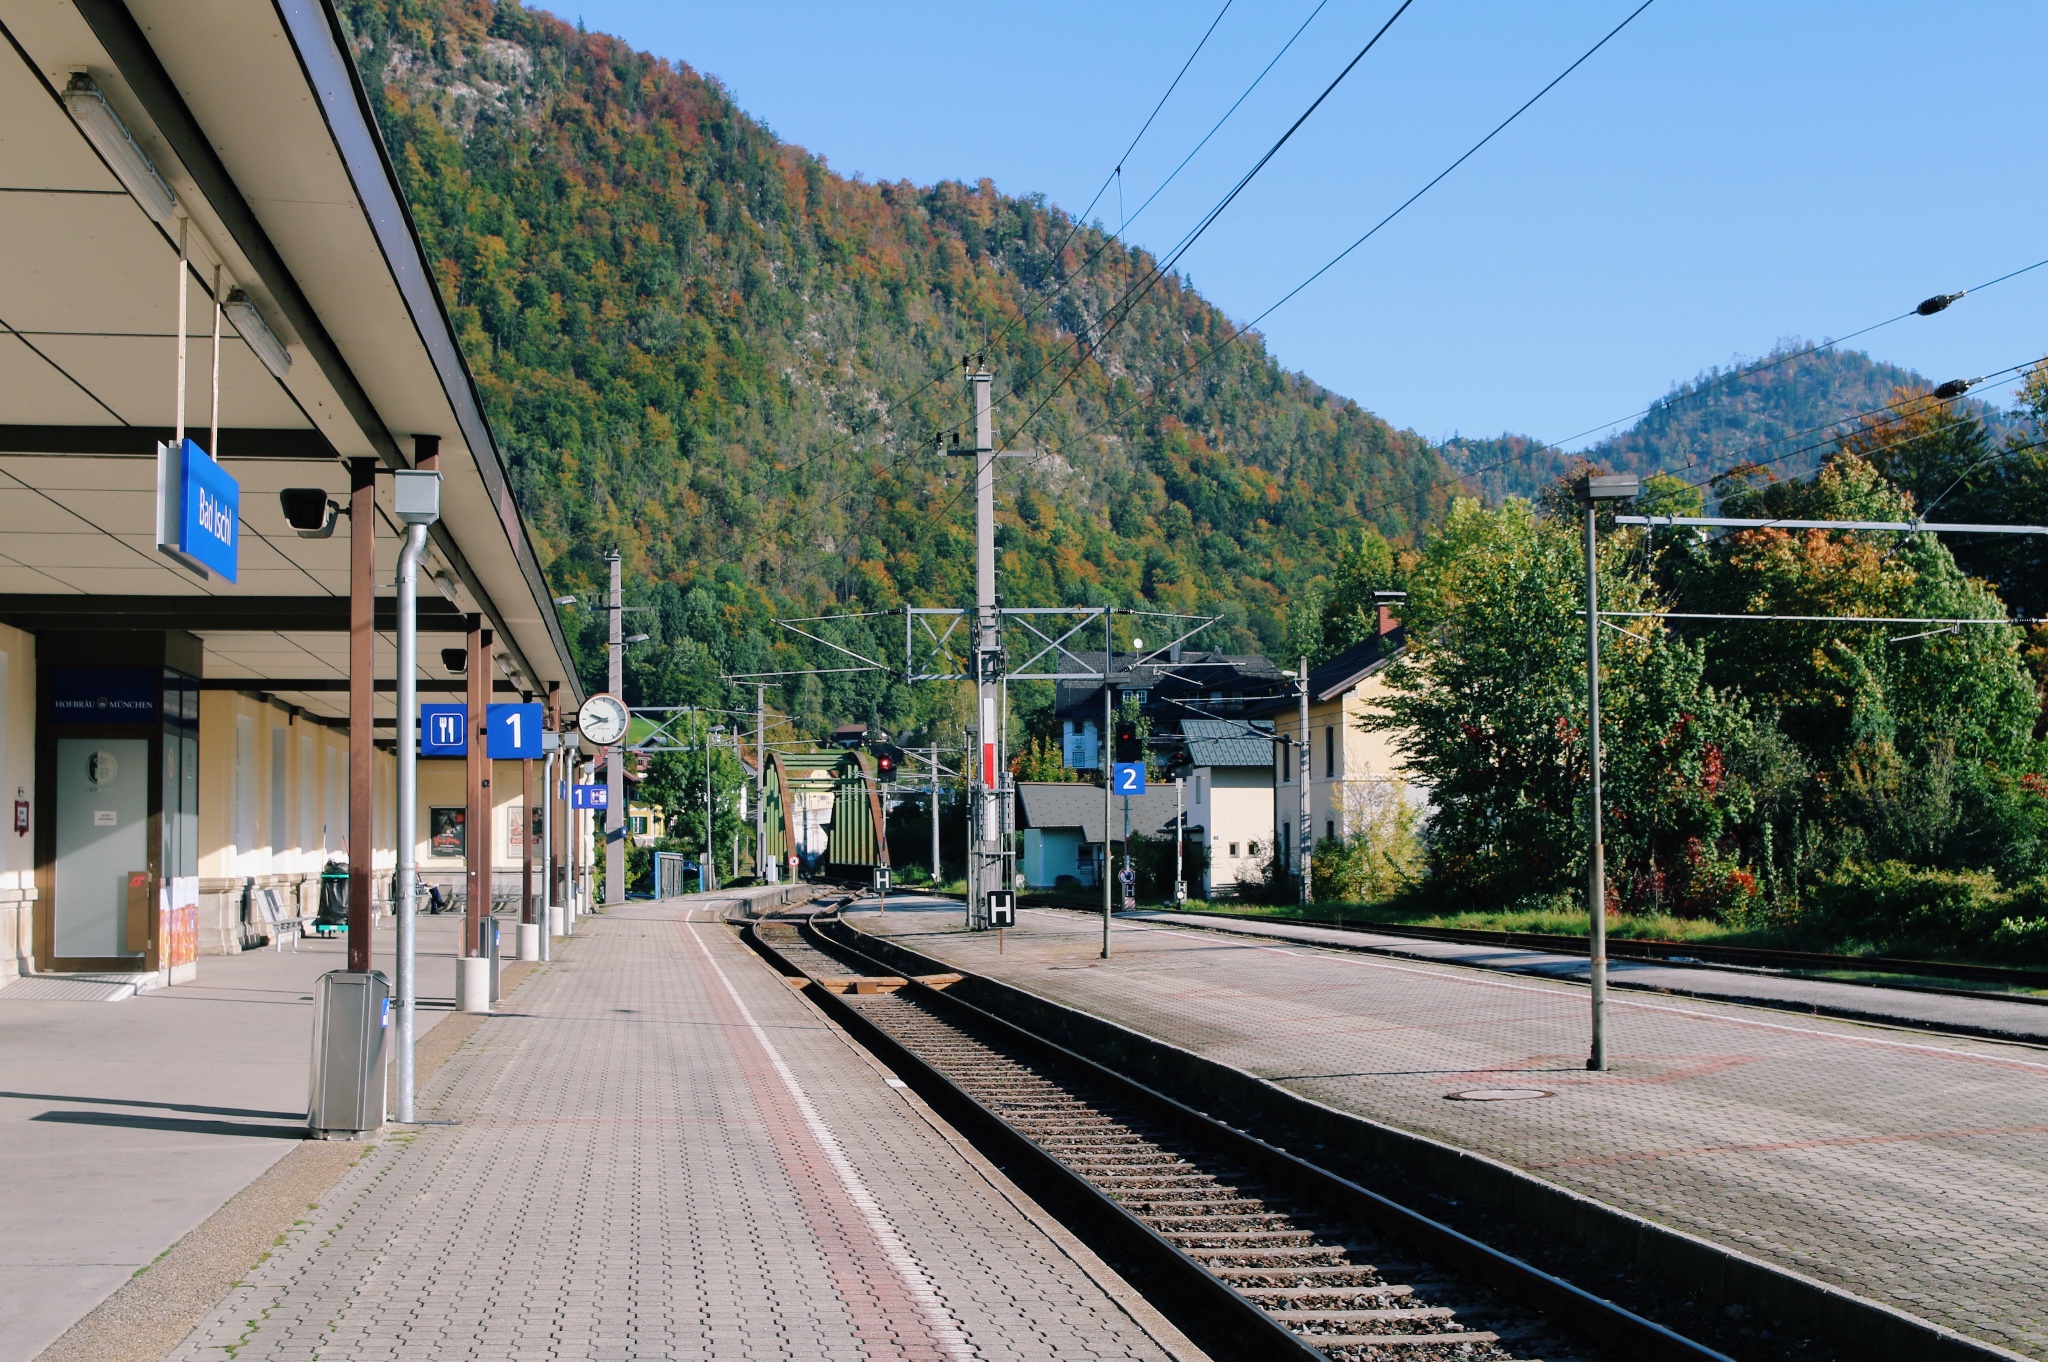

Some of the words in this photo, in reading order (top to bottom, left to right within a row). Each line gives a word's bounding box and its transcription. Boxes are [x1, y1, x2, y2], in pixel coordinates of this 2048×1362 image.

[199, 487, 214, 533] Bad
[214, 500, 233, 547] Ischl
[55, 700, 95, 708] HOFBRÄU
[109, 700, 153, 709] MÜNCHEN
[505, 712, 522, 748] 1
[1122, 768, 1137, 790] 2
[574, 788, 583, 805] 1
[876, 871, 889, 888] H
[1126, 884, 1135, 897] H
[990, 895, 1011, 923] H
